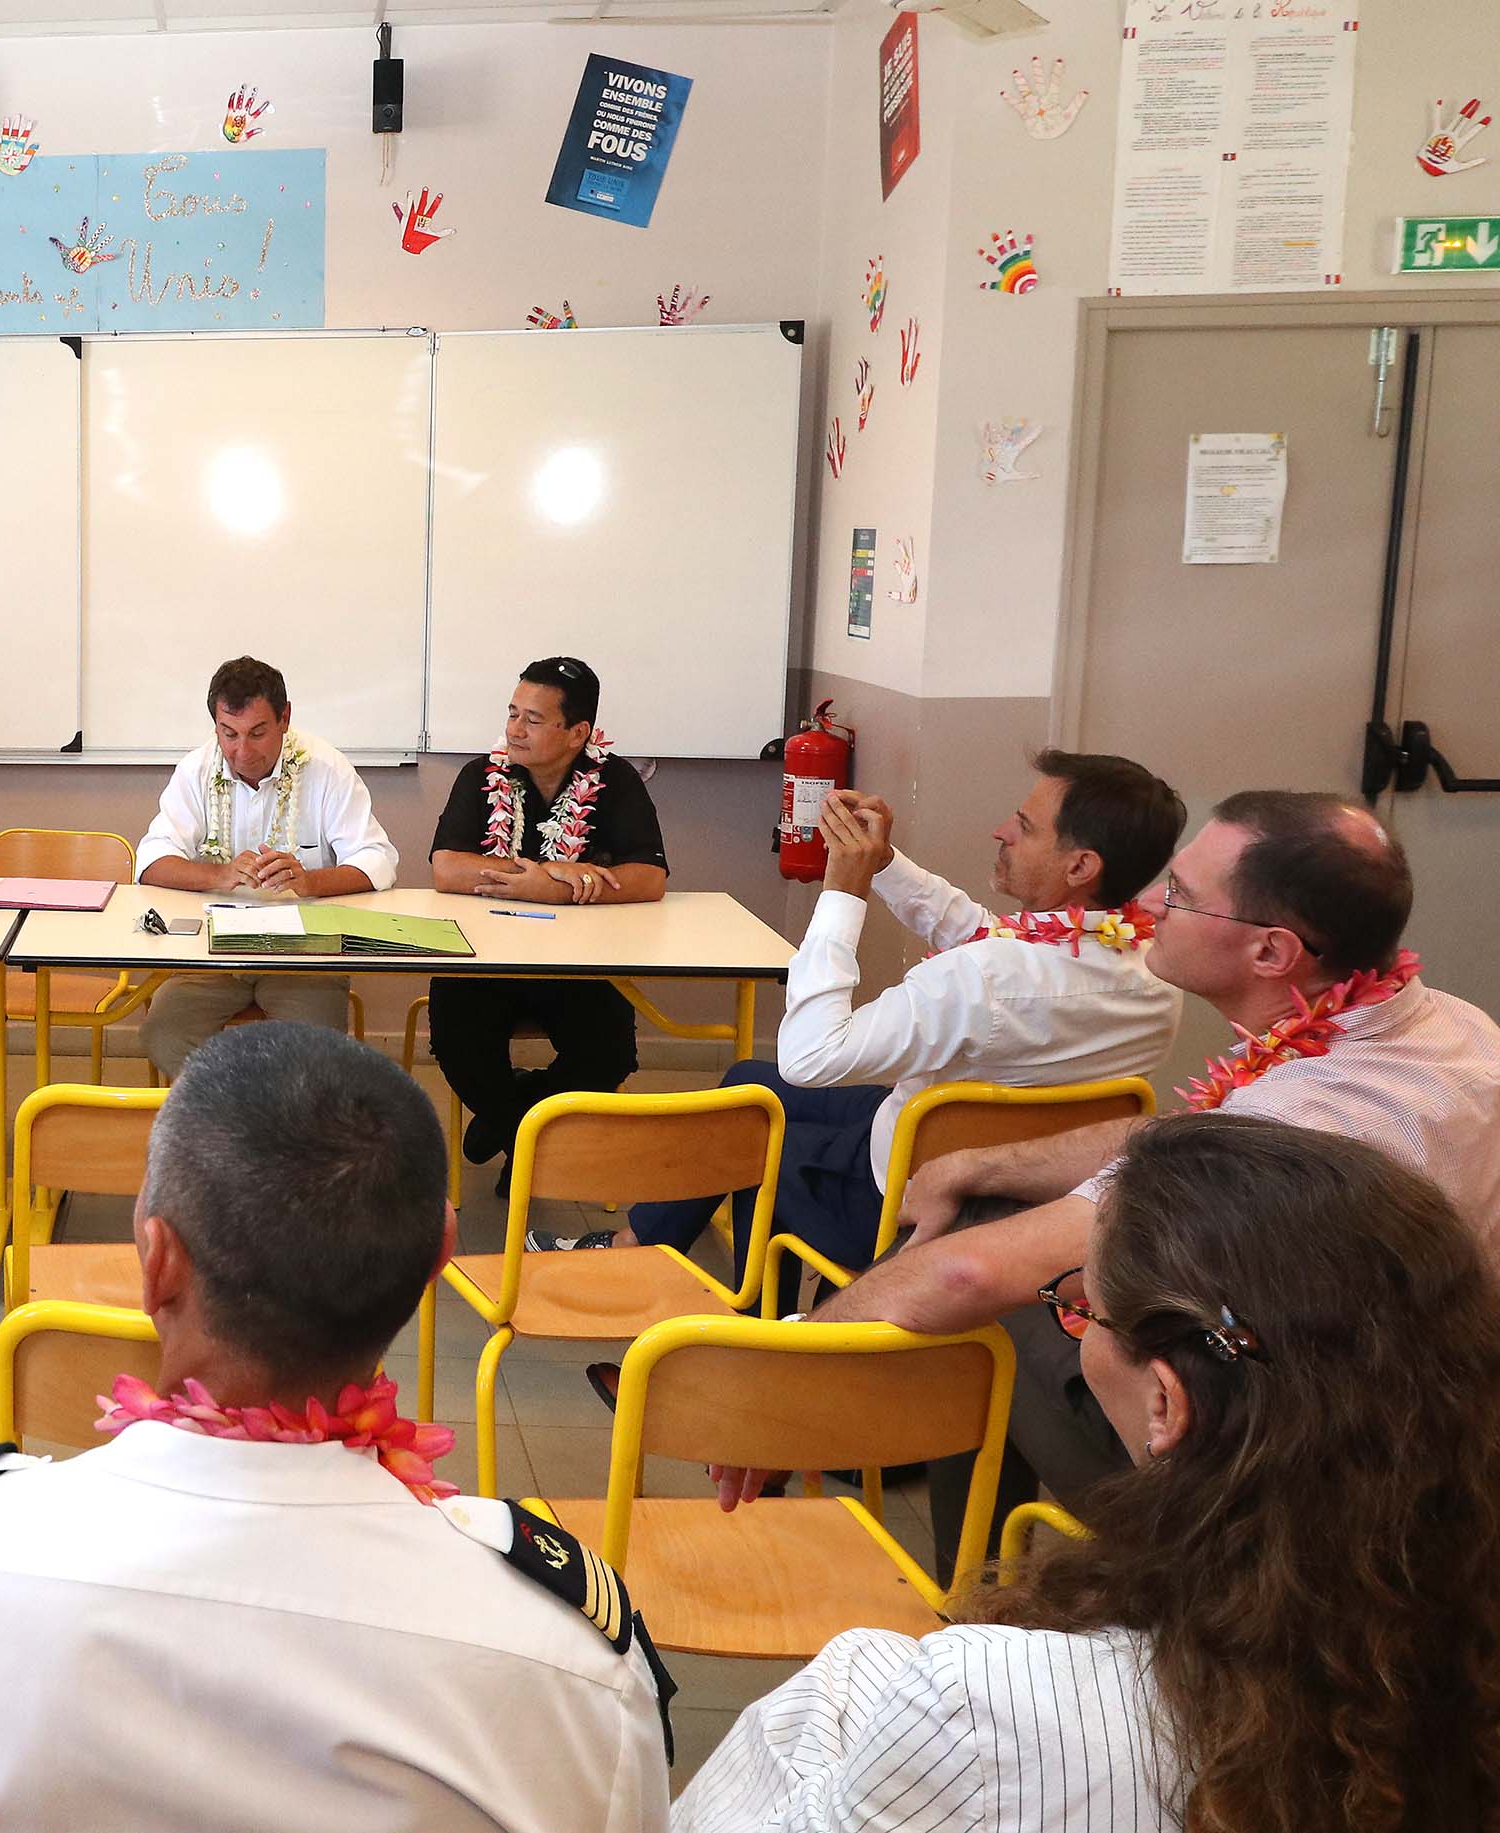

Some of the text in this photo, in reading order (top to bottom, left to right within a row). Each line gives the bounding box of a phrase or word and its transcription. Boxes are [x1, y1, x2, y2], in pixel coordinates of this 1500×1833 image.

[599, 101, 622, 112] COMME
[622, 107, 634, 115] DES
[601, 88, 664, 112] ENSEMBLE
[593, 118, 652, 142] COMME DES
[606, 112, 625, 124] NOUS
[625, 117, 656, 131] FINIRONS
